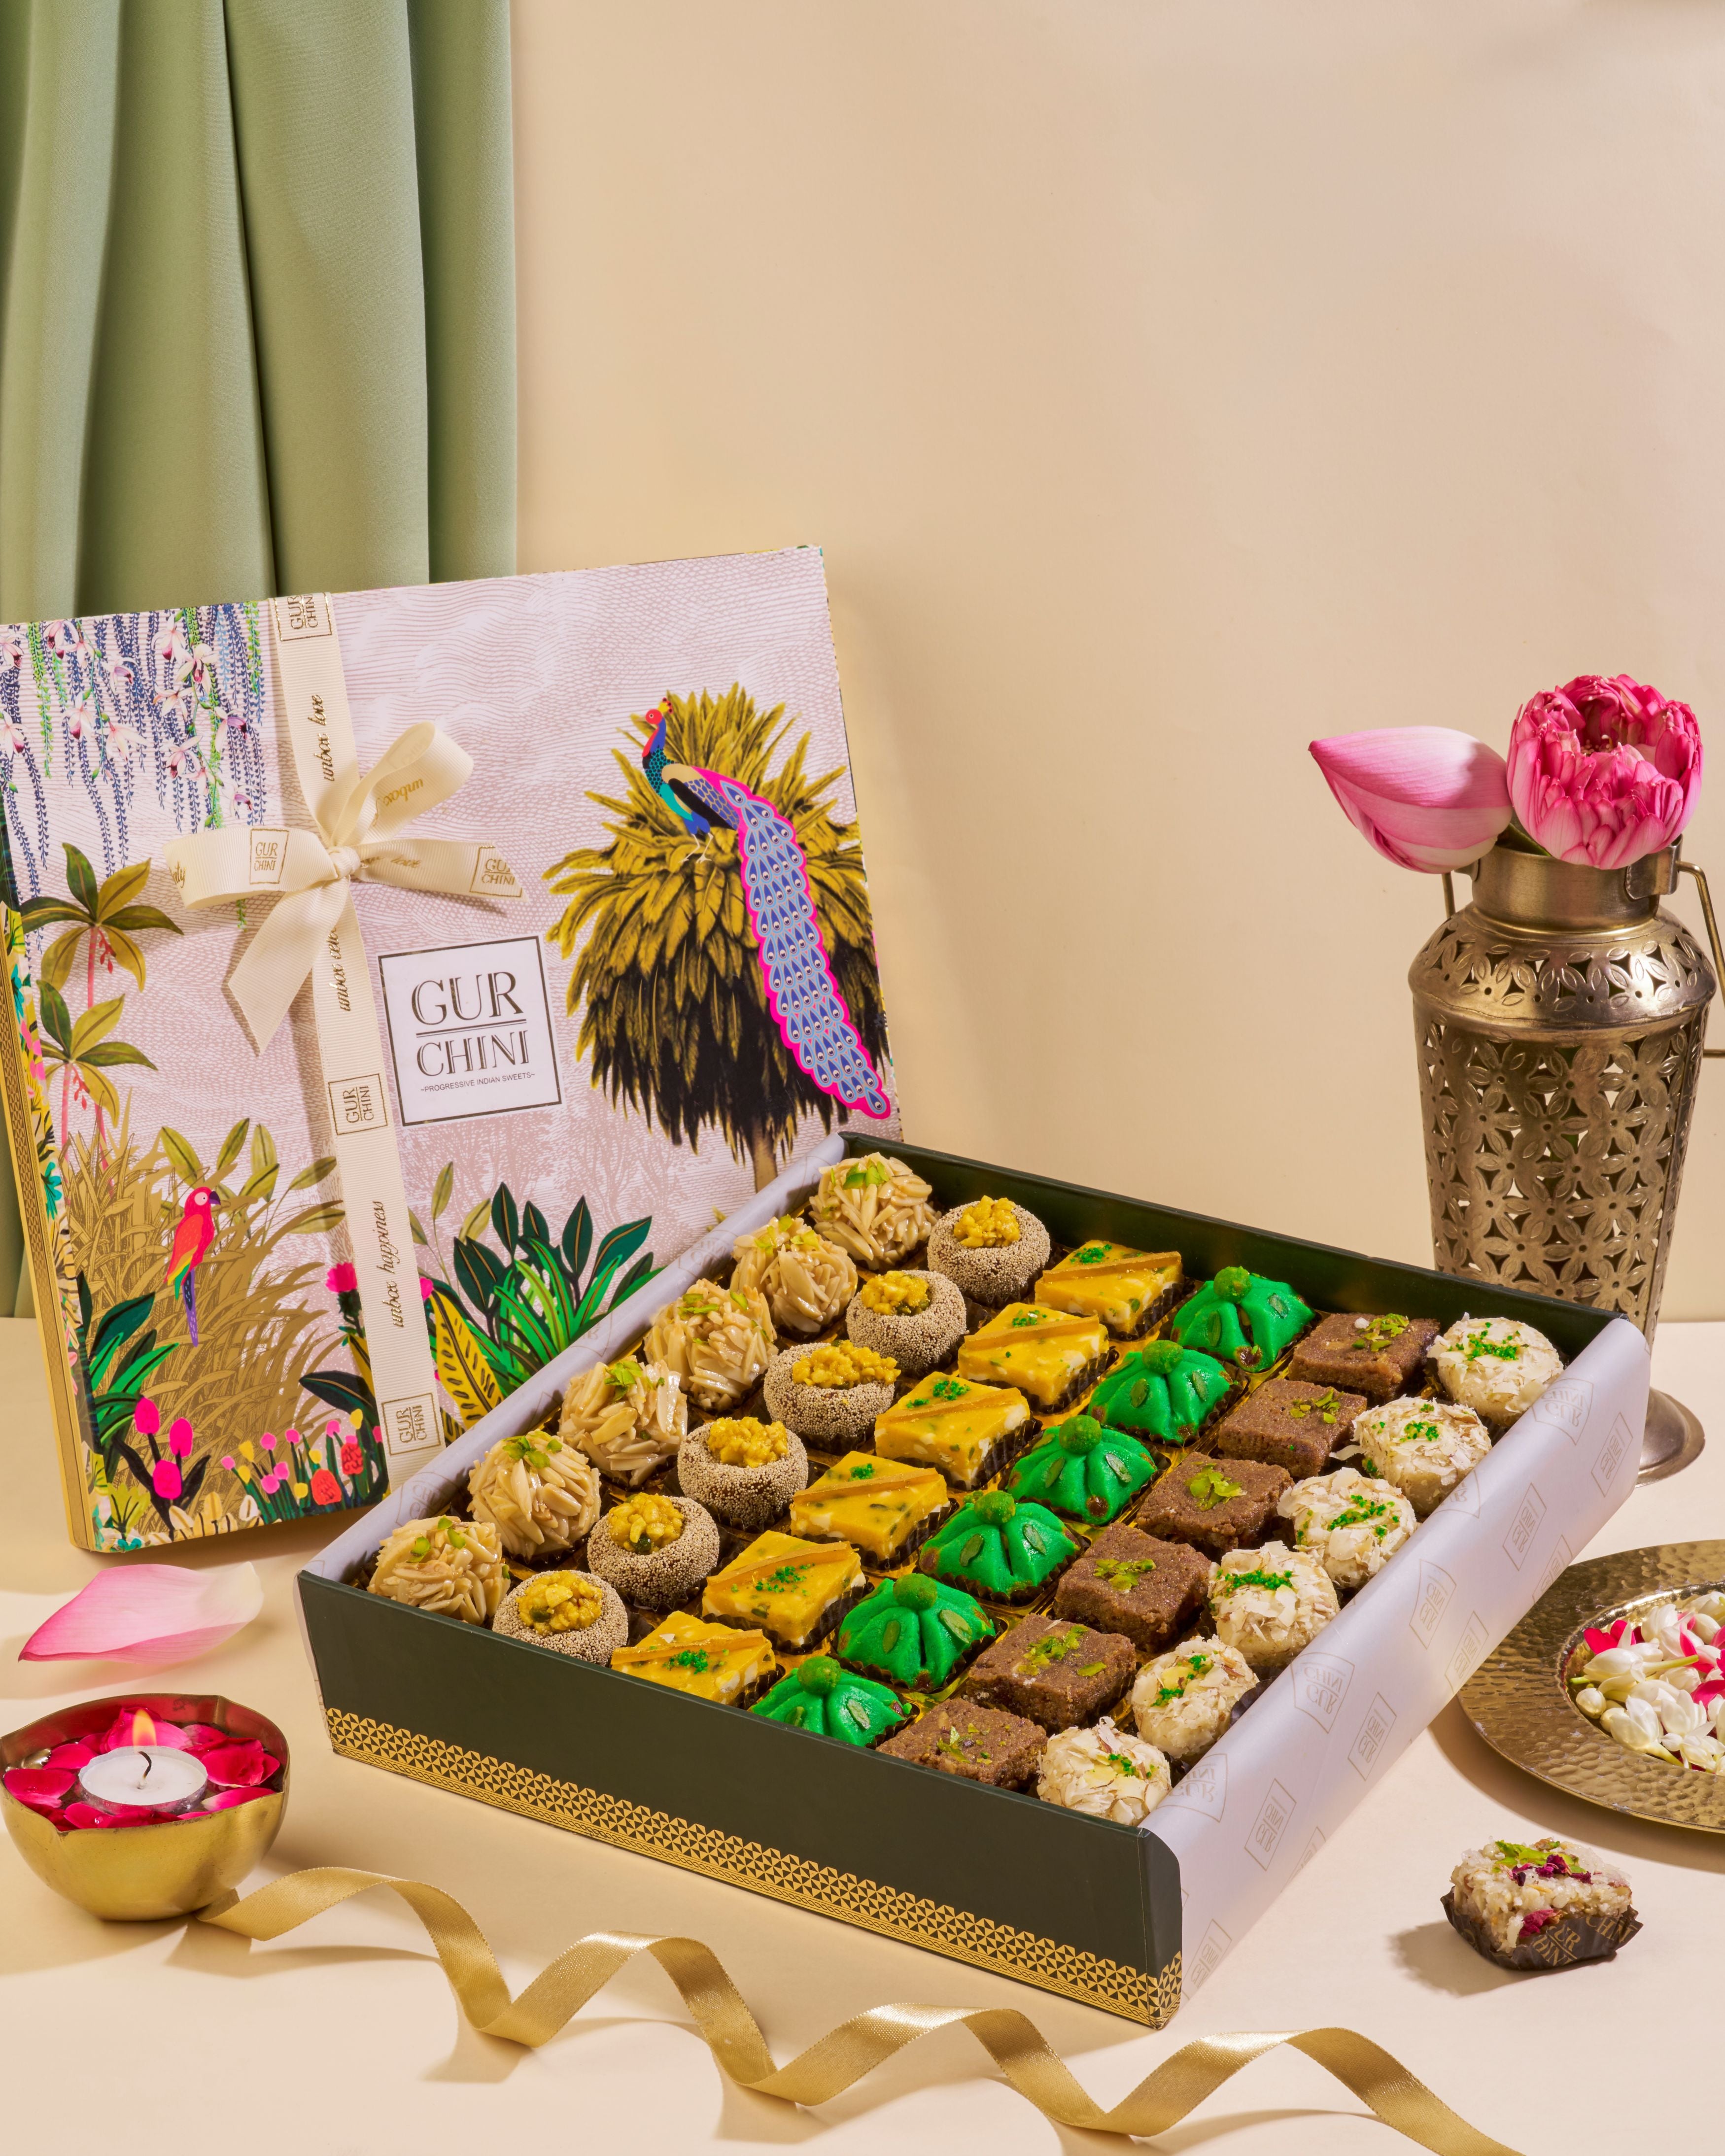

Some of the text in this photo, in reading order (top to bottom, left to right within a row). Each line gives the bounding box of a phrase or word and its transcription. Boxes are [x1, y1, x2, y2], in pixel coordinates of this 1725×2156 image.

[287, 594, 304, 629] GUR
[307, 694, 335, 782] unbox love
[254, 860, 277, 872] CHINI
[255, 842, 278, 856] GUR
[485, 858, 511, 872] GU
[329, 963, 351, 1012] unbox
[411, 971, 524, 1026] GUR
[416, 1030, 530, 1077] CHINI
[477, 1075, 501, 1086] INDIAN
[343, 1088, 360, 1123] GUR
[359, 1086, 374, 1121] CHINI
[372, 1200, 404, 1328] unbox happiness
[396, 1407, 414, 1443] GUR
[412, 1405, 427, 1440] CHINI
